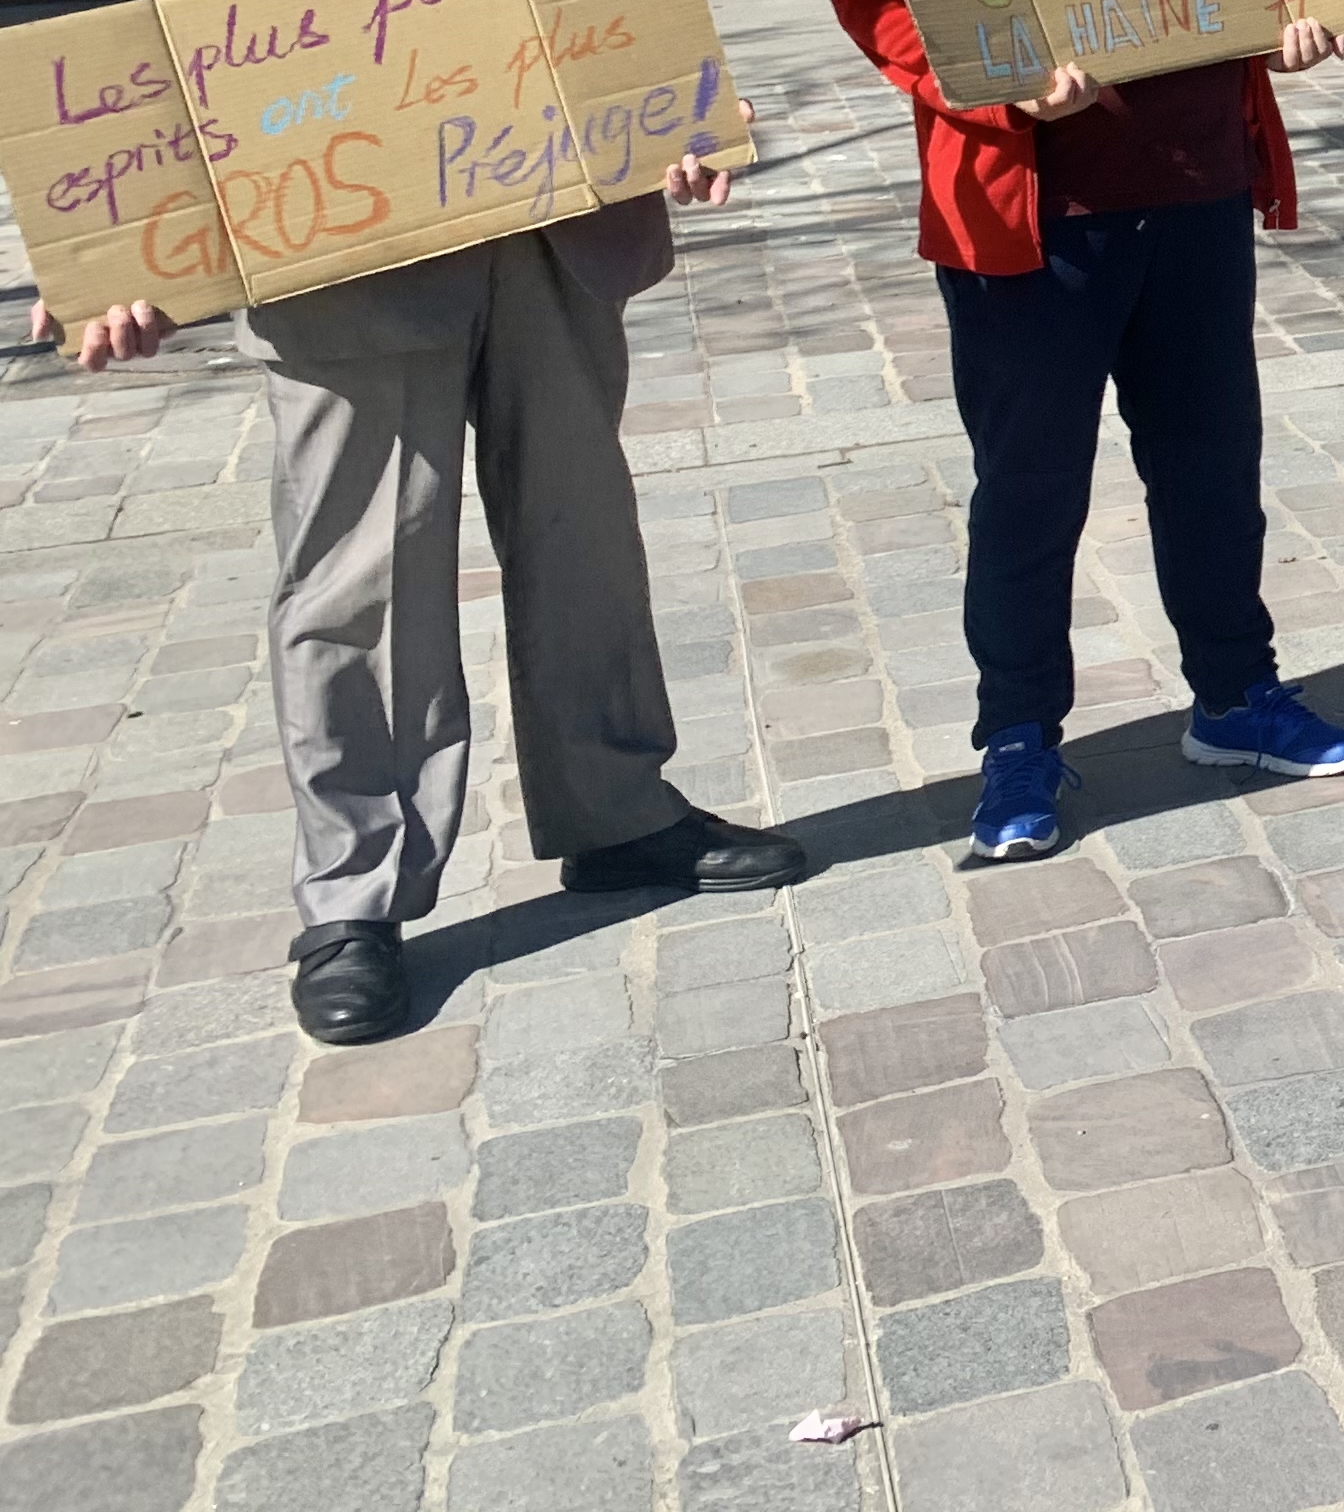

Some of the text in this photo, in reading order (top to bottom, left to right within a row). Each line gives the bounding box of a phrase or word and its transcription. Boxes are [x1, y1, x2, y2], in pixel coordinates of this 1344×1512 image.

[47, 118, 240, 224] esprits
[260, 73, 357, 136] ont
[507, 6, 636, 110] plus
[53, 56, 172, 126] Les
[186, 4, 330, 108] plus
[977, 15, 1049, 84] LA
[140, 131, 391, 281] GROS
